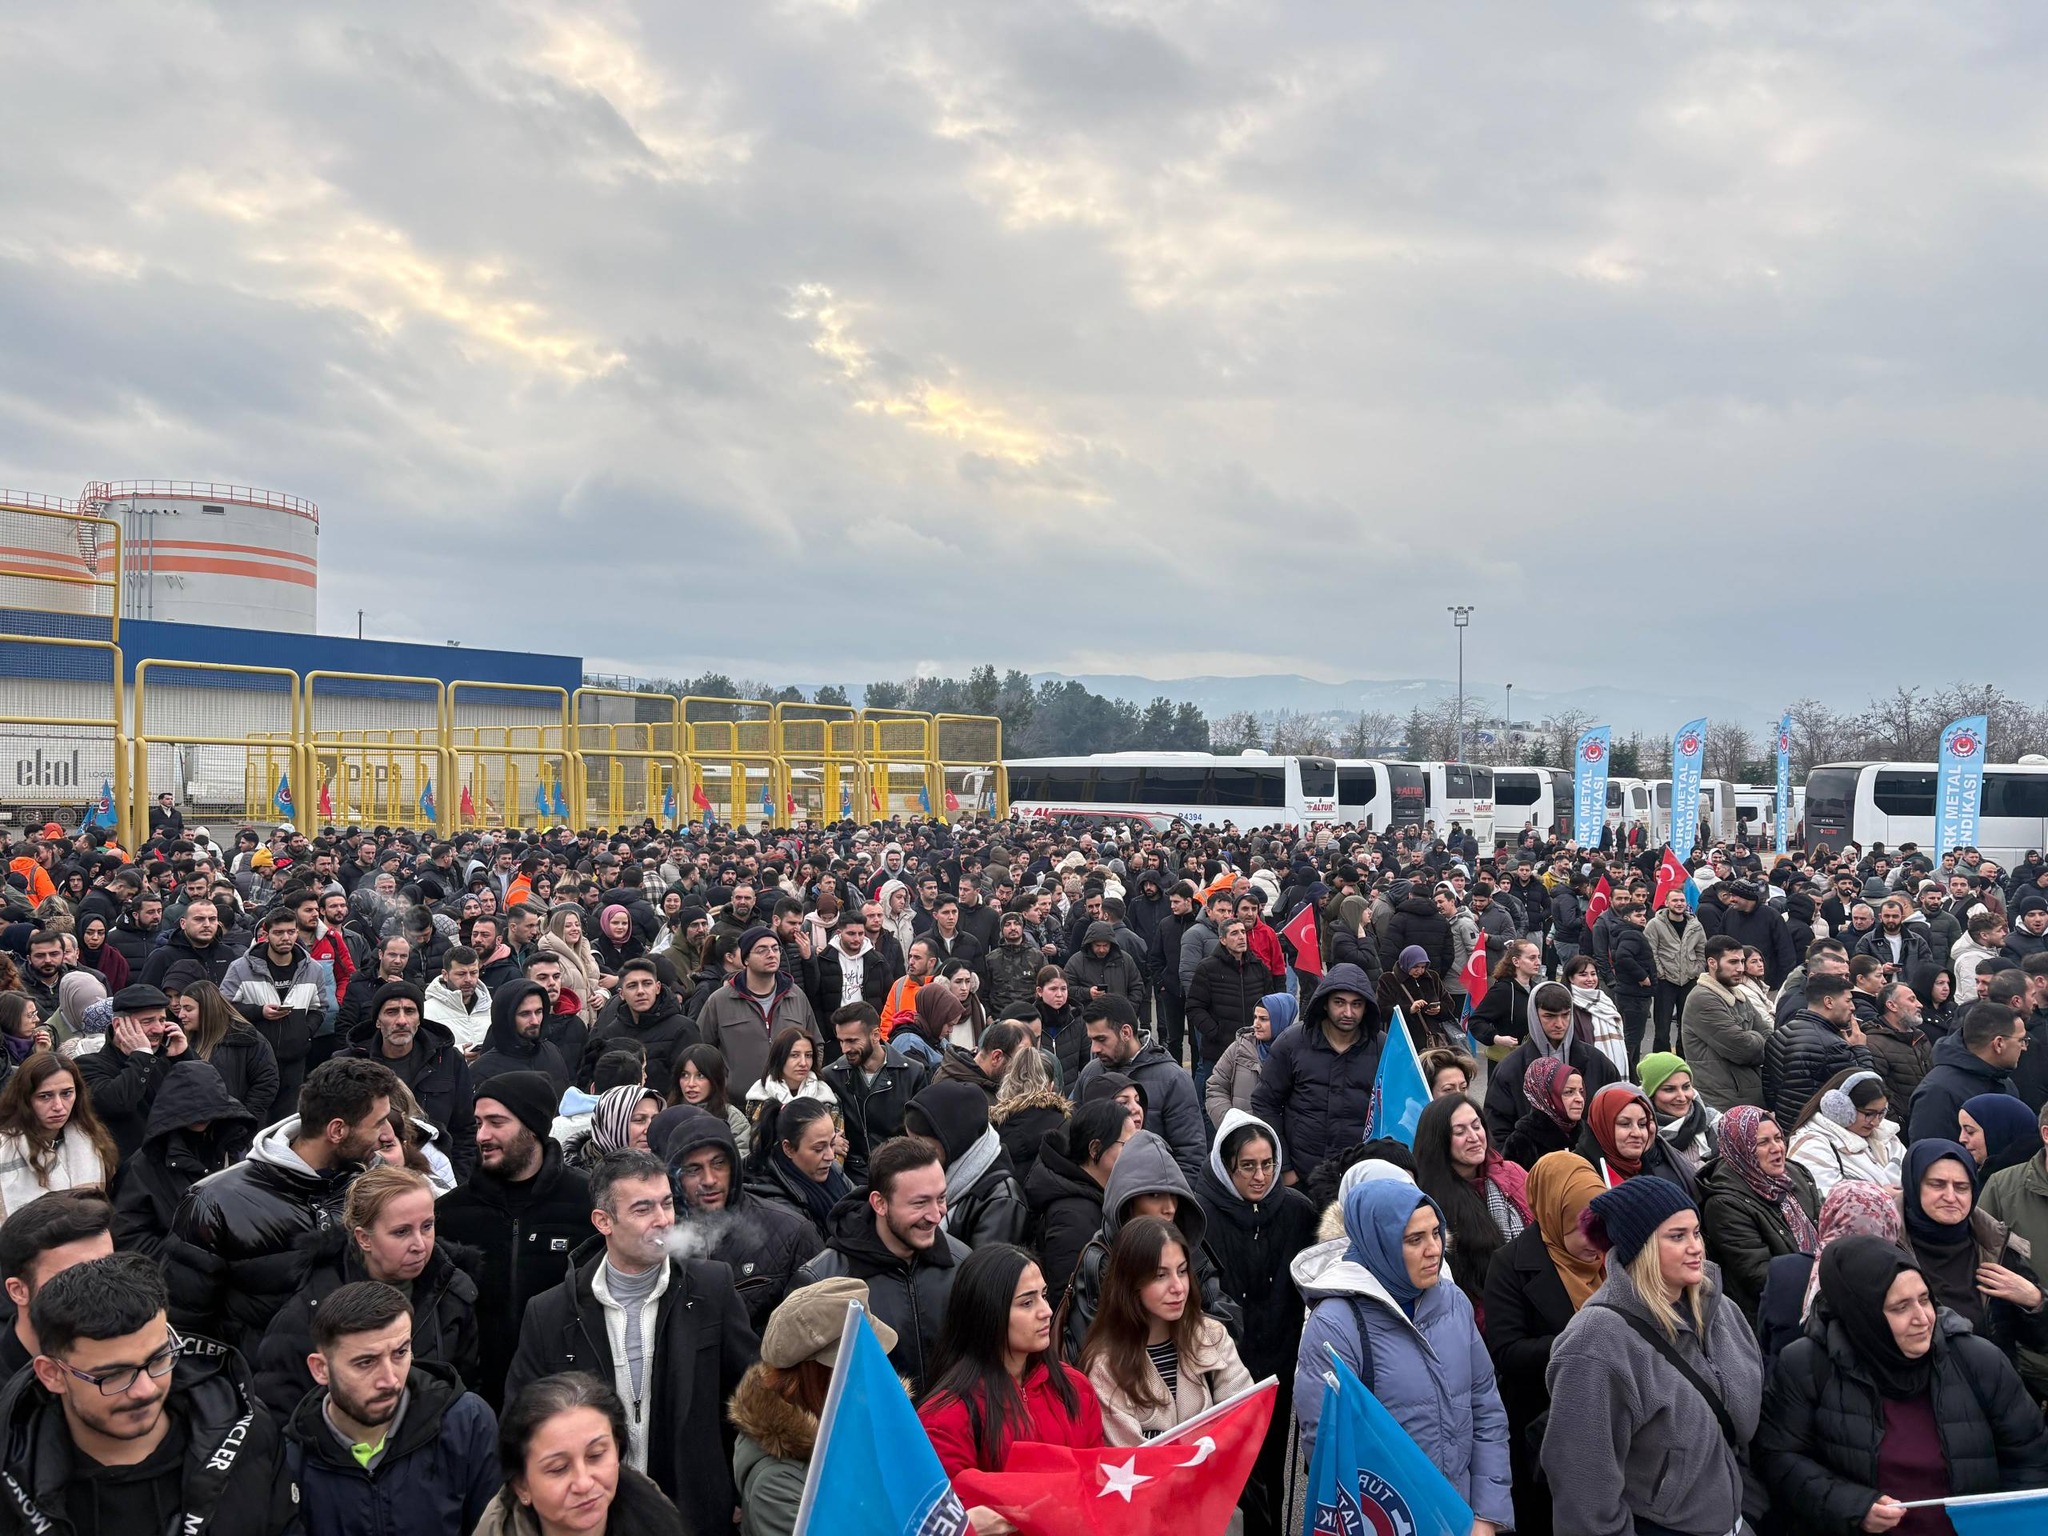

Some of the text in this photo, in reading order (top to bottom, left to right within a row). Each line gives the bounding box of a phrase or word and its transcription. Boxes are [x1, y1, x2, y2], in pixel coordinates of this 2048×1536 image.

[17, 748, 78, 786] ekol
[1677, 763, 1689, 812] METAL
[1312, 803, 1333, 811] ALTUR
[1580, 769, 1593, 817] METAL
[1684, 769, 1699, 849] SENDİKASI
[1945, 765, 1962, 819] METAL
[1960, 773, 1977, 849] ENDİKASI
